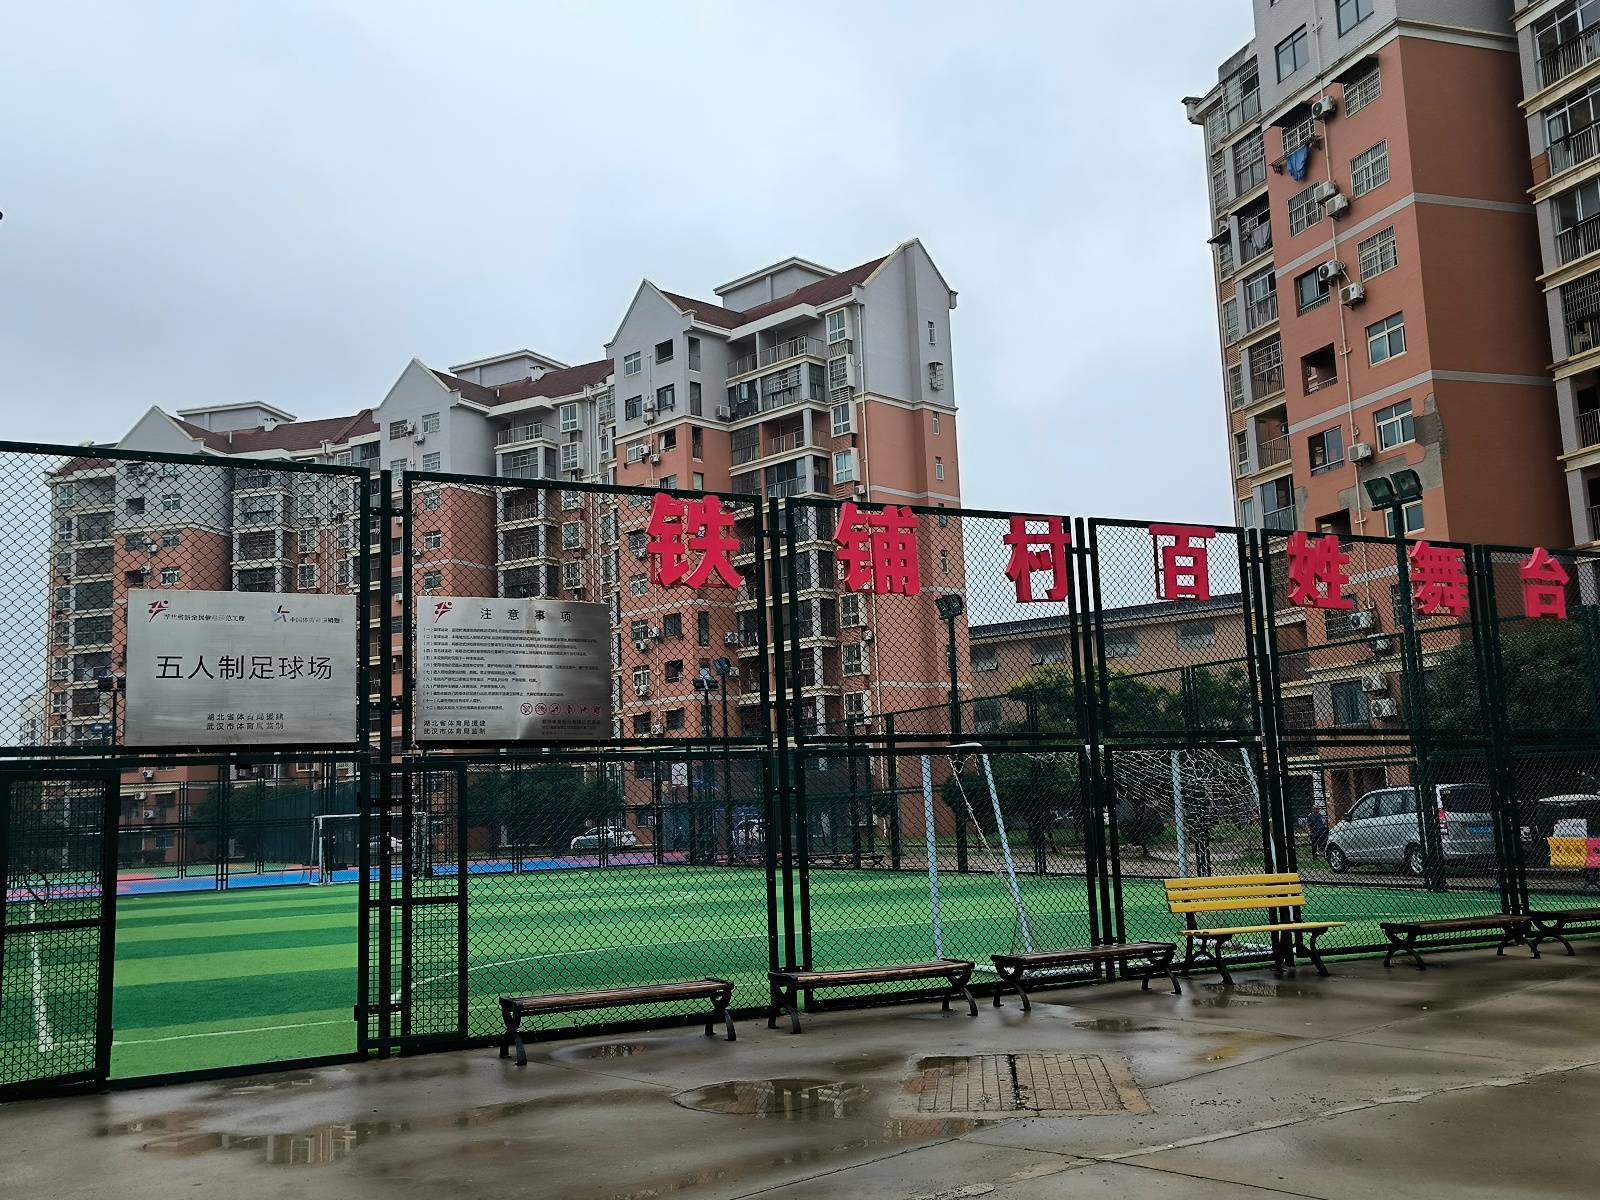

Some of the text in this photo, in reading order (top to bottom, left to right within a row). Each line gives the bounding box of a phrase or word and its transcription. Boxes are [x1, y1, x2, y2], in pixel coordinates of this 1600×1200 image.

[647, 492, 1570, 620] 铁铺村百姓舞台
[480, 607, 572, 623] 注意事项
[155, 655, 332, 680] 五人制足球场
